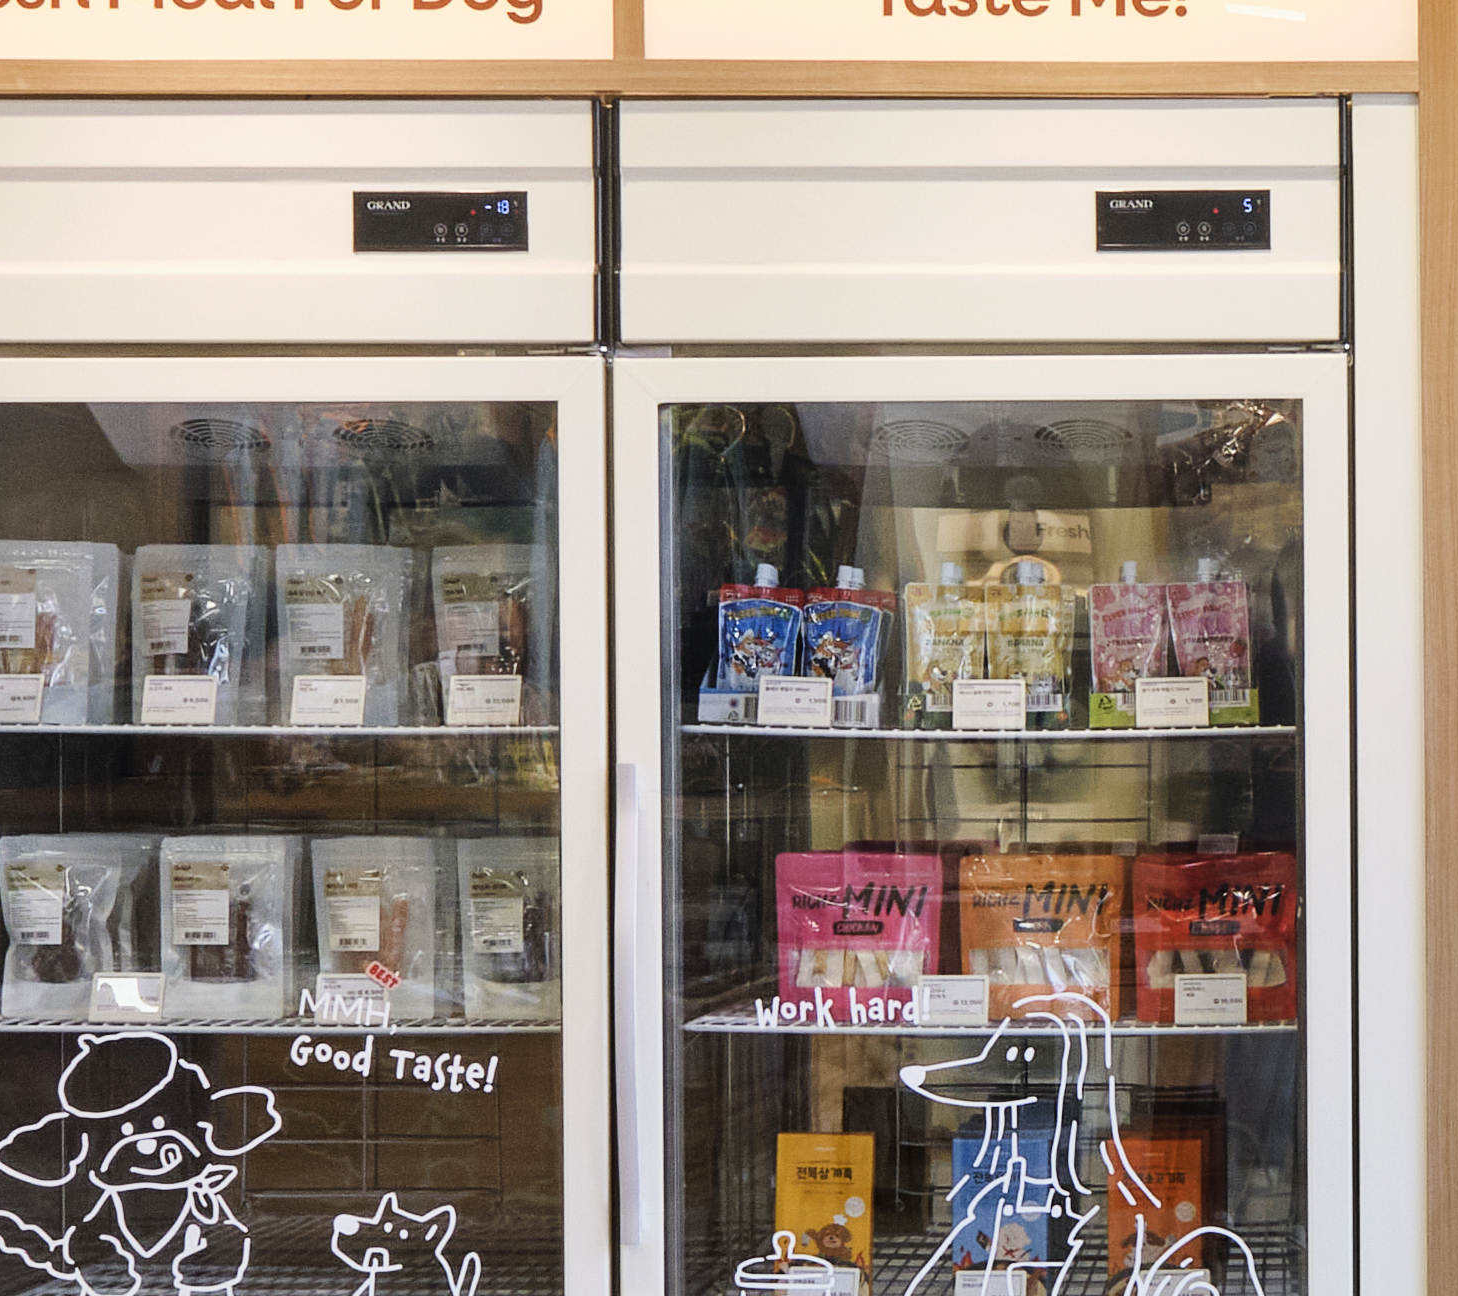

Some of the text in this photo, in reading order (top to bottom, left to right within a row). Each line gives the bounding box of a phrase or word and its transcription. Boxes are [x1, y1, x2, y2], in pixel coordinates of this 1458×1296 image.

[367, 200, 411, 210] GRAND
[1109, 199, 1154, 209] GRAND
[843, 882, 928, 920] MINI
[1022, 881, 1109, 921] MINI
[1198, 882, 1285, 920] MINI
[368, 962, 400, 989] BEST
[298, 988, 398, 1035] MMH,
[755, 985, 932, 1030] Work hard!
[290, 1034, 499, 1093] Good Taste!
